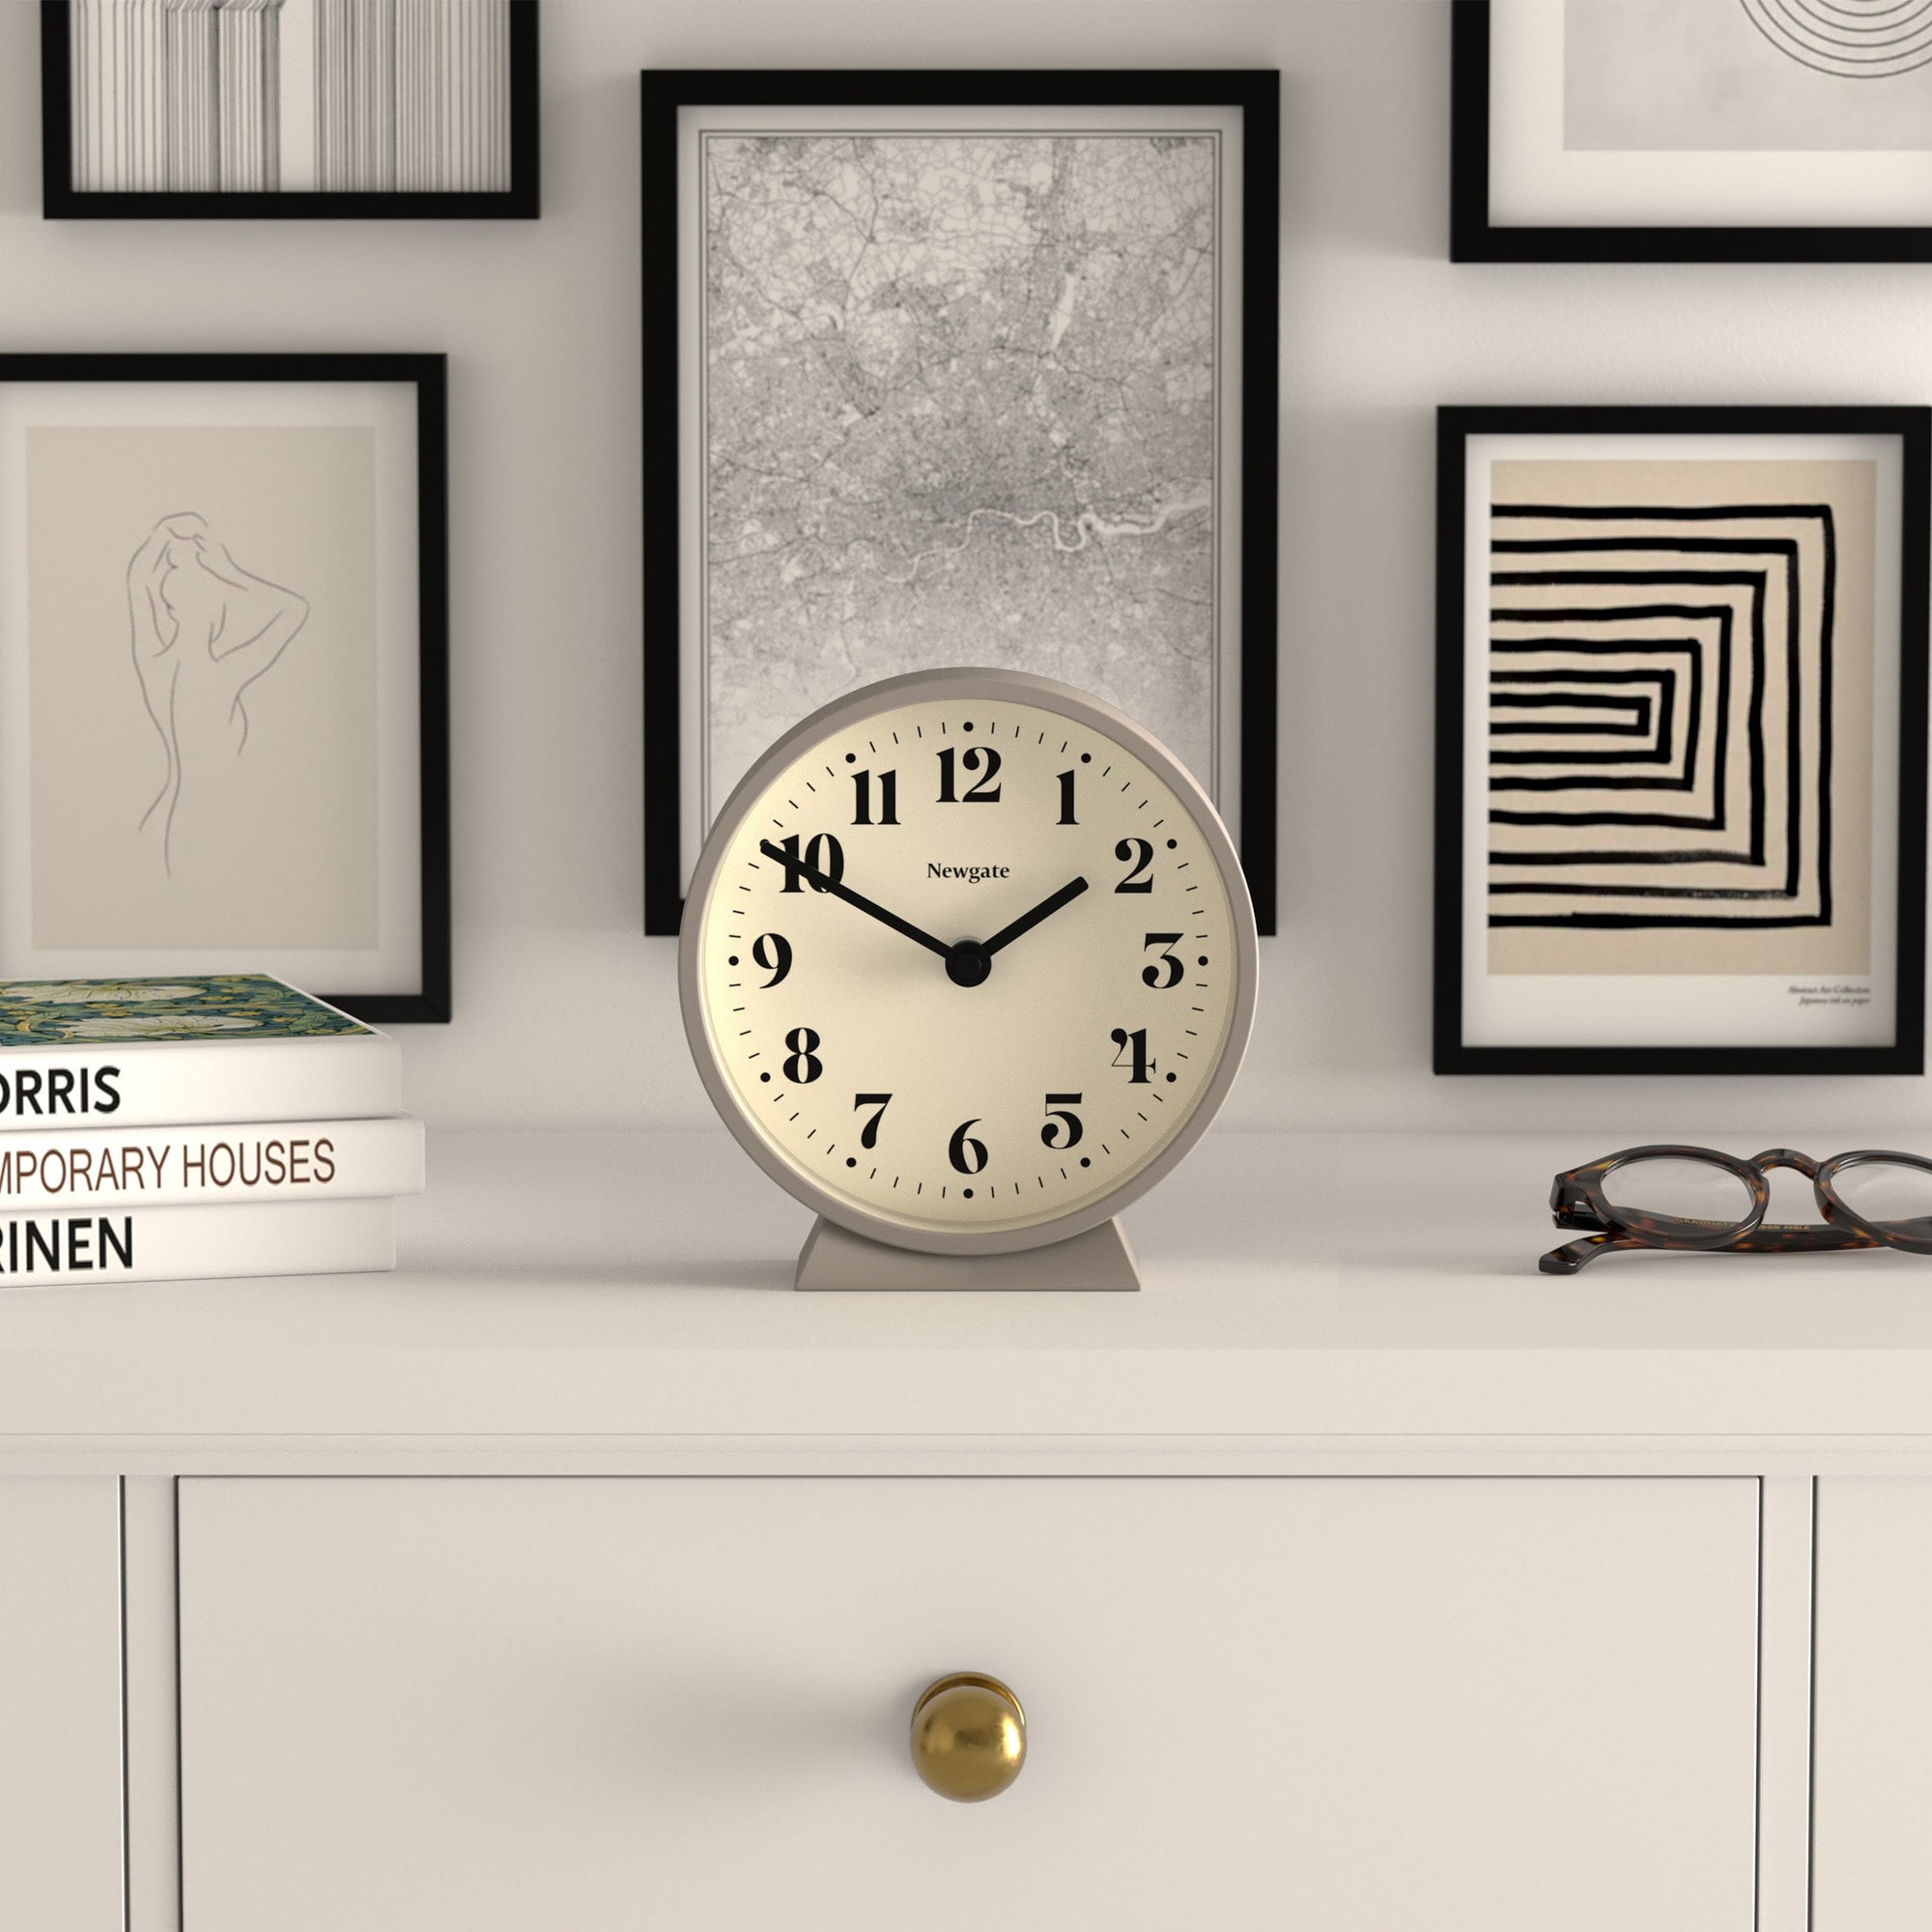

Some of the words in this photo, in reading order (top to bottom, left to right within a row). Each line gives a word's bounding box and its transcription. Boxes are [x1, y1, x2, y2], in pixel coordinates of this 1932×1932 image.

[850, 769, 901, 826] 11
[935, 746, 1002, 803] 12
[1055, 769, 1080, 826] 1
[779, 833, 845, 895] 10
[926, 863, 1010, 883] Newgate
[1114, 838, 1154, 895] 2
[752, 932, 793, 989] 9
[1141, 932, 1184, 989] 3
[782, 1027, 823, 1085] 8
[1110, 1027, 1156, 1084] 4
[0, 1065, 121, 1116] RRIS
[854, 1093, 894, 1150] 7
[948, 1119, 989, 1175] 6
[1040, 1092, 1084, 1150] 5
[183, 1138, 336, 1188] HOUSES
[0, 1216, 133, 1273] INEN
